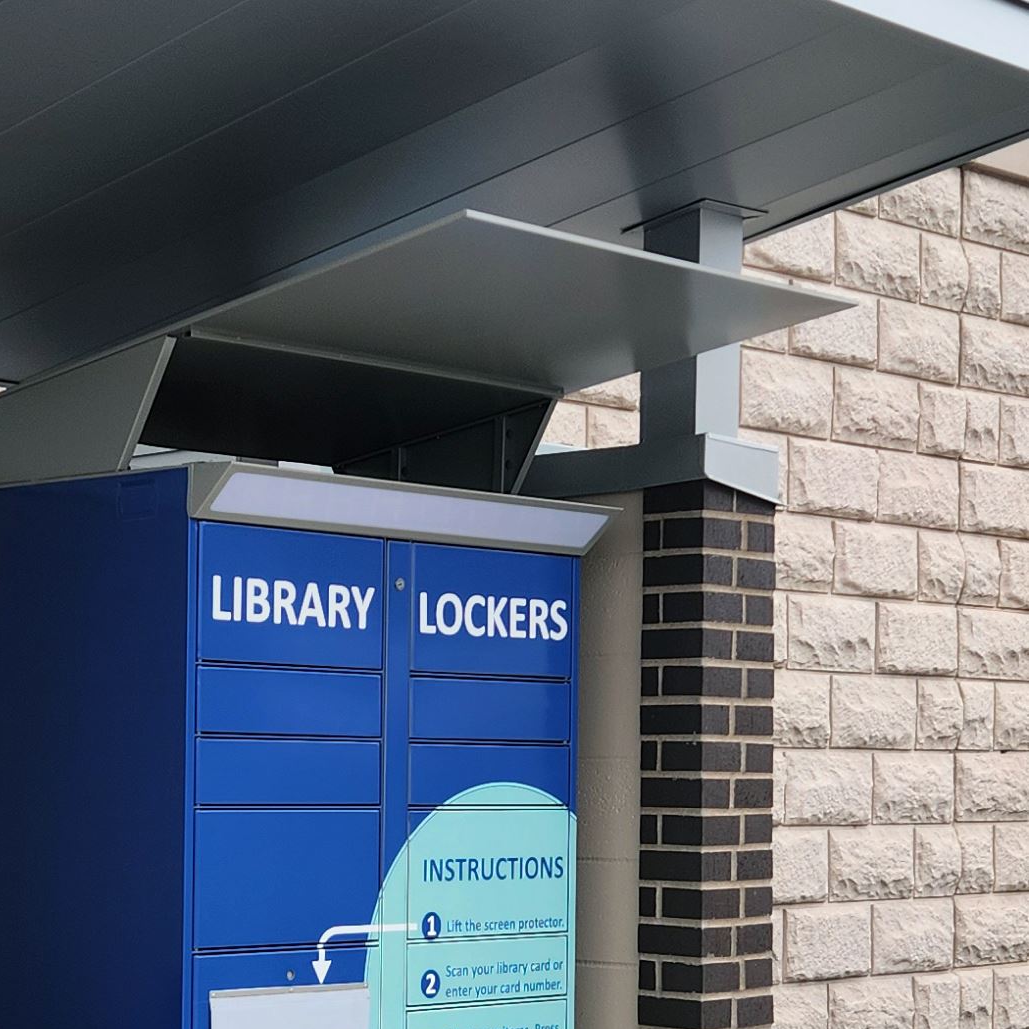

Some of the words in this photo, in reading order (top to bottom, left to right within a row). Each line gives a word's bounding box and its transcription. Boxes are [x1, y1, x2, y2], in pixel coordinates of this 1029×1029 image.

[212, 575, 375, 630] LIBRARY
[419, 591, 568, 642] LOCKERS
[423, 857, 564, 882] INSTRUCTIONS
[427, 916, 437, 936] 1
[447, 921, 463, 932] Lift
[465, 920, 481, 932] the
[484, 919, 515, 931] screen
[518, 917, 564, 932] protector.
[425, 974, 436, 995] 2
[445, 964, 468, 977] Scan
[471, 963, 494, 978] your
[496, 961, 528, 976] library
[530, 960, 550, 972] card
[552, 960, 563, 972] or
[445, 985, 472, 997] enter
[474, 983, 497, 998] your
[500, 981, 521, 993] card
[522, 979, 562, 992] number.
